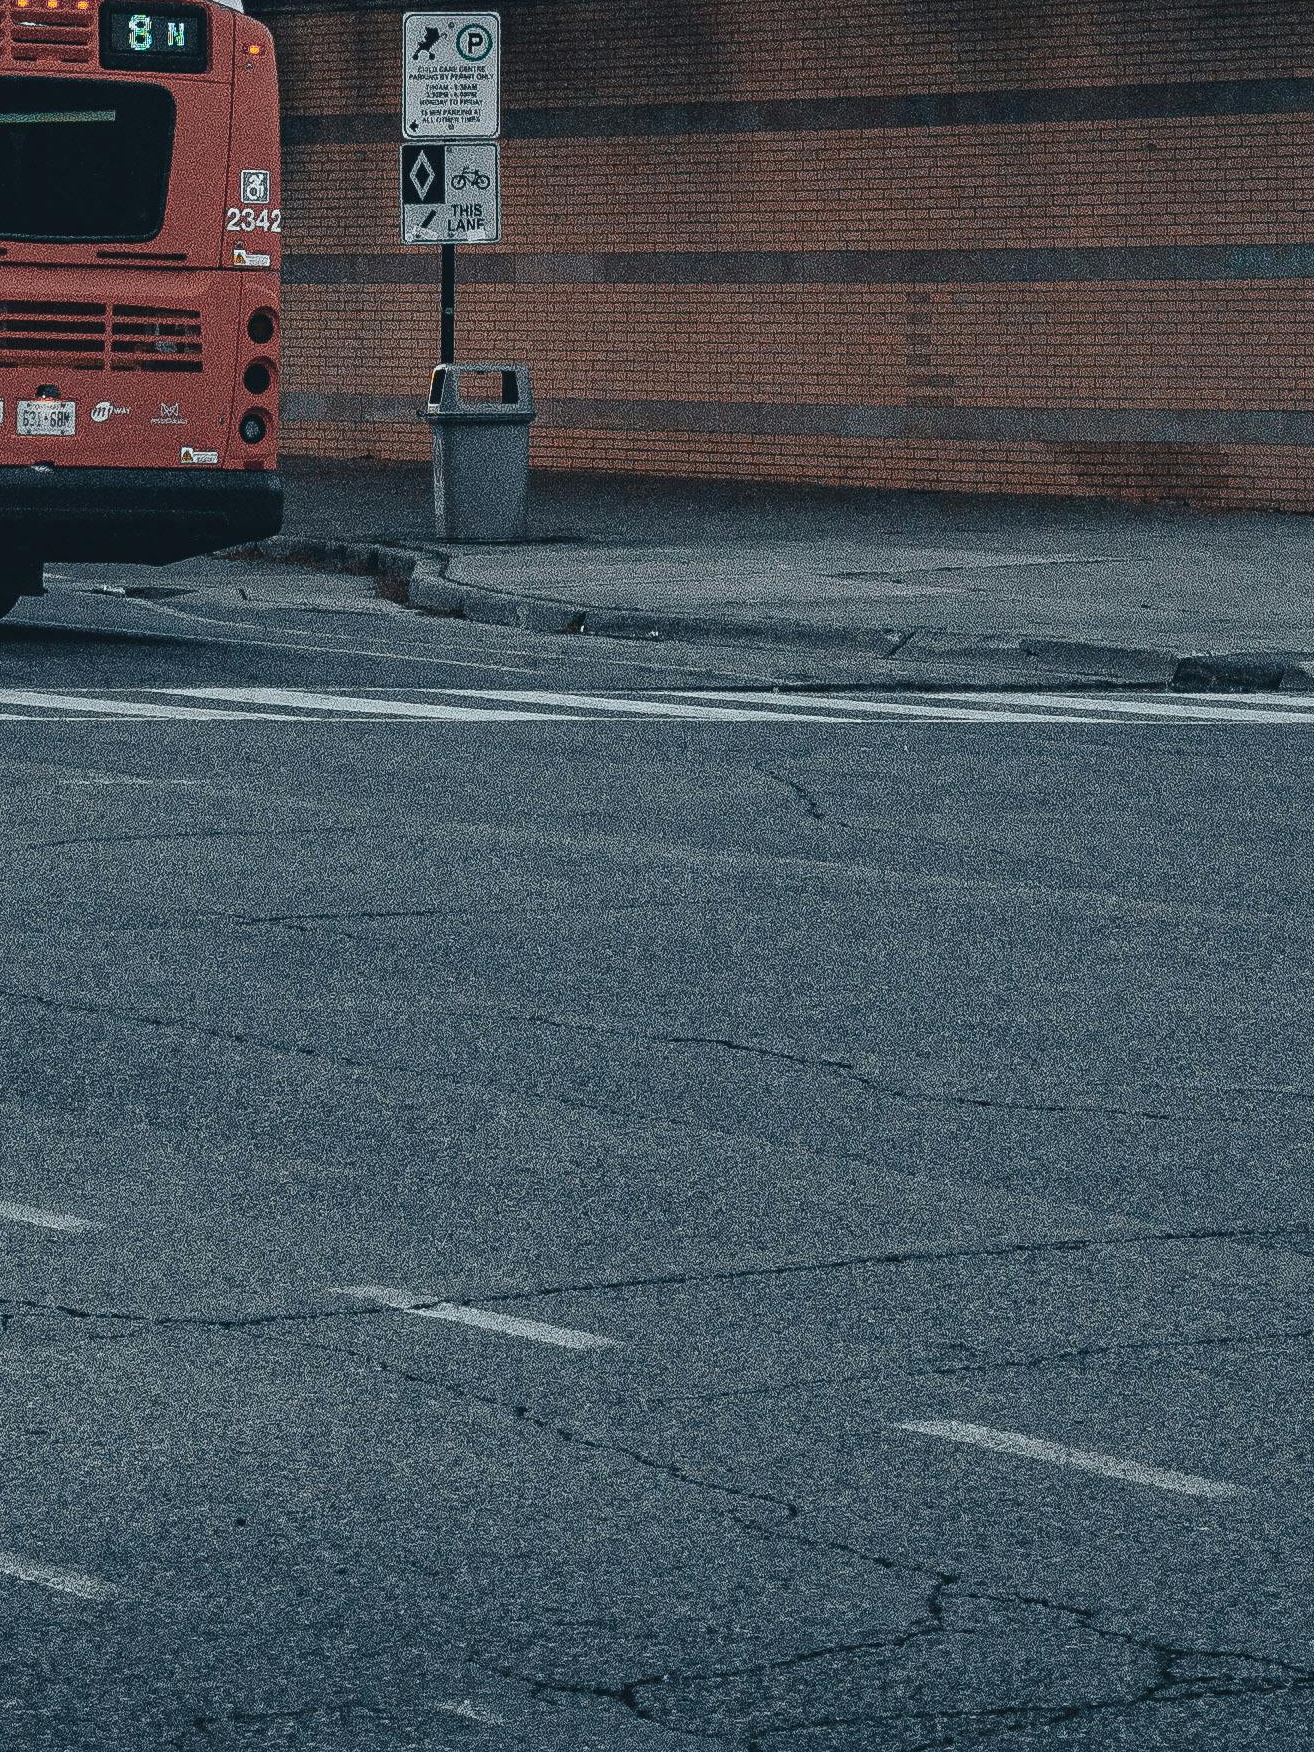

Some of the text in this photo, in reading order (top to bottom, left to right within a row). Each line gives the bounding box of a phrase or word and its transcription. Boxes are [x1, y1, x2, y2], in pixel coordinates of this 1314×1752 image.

[128, 14, 185, 51] 8 N
[468, 32, 483, 54] P
[226, 207, 282, 233] 2342
[451, 204, 483, 217] THIS
